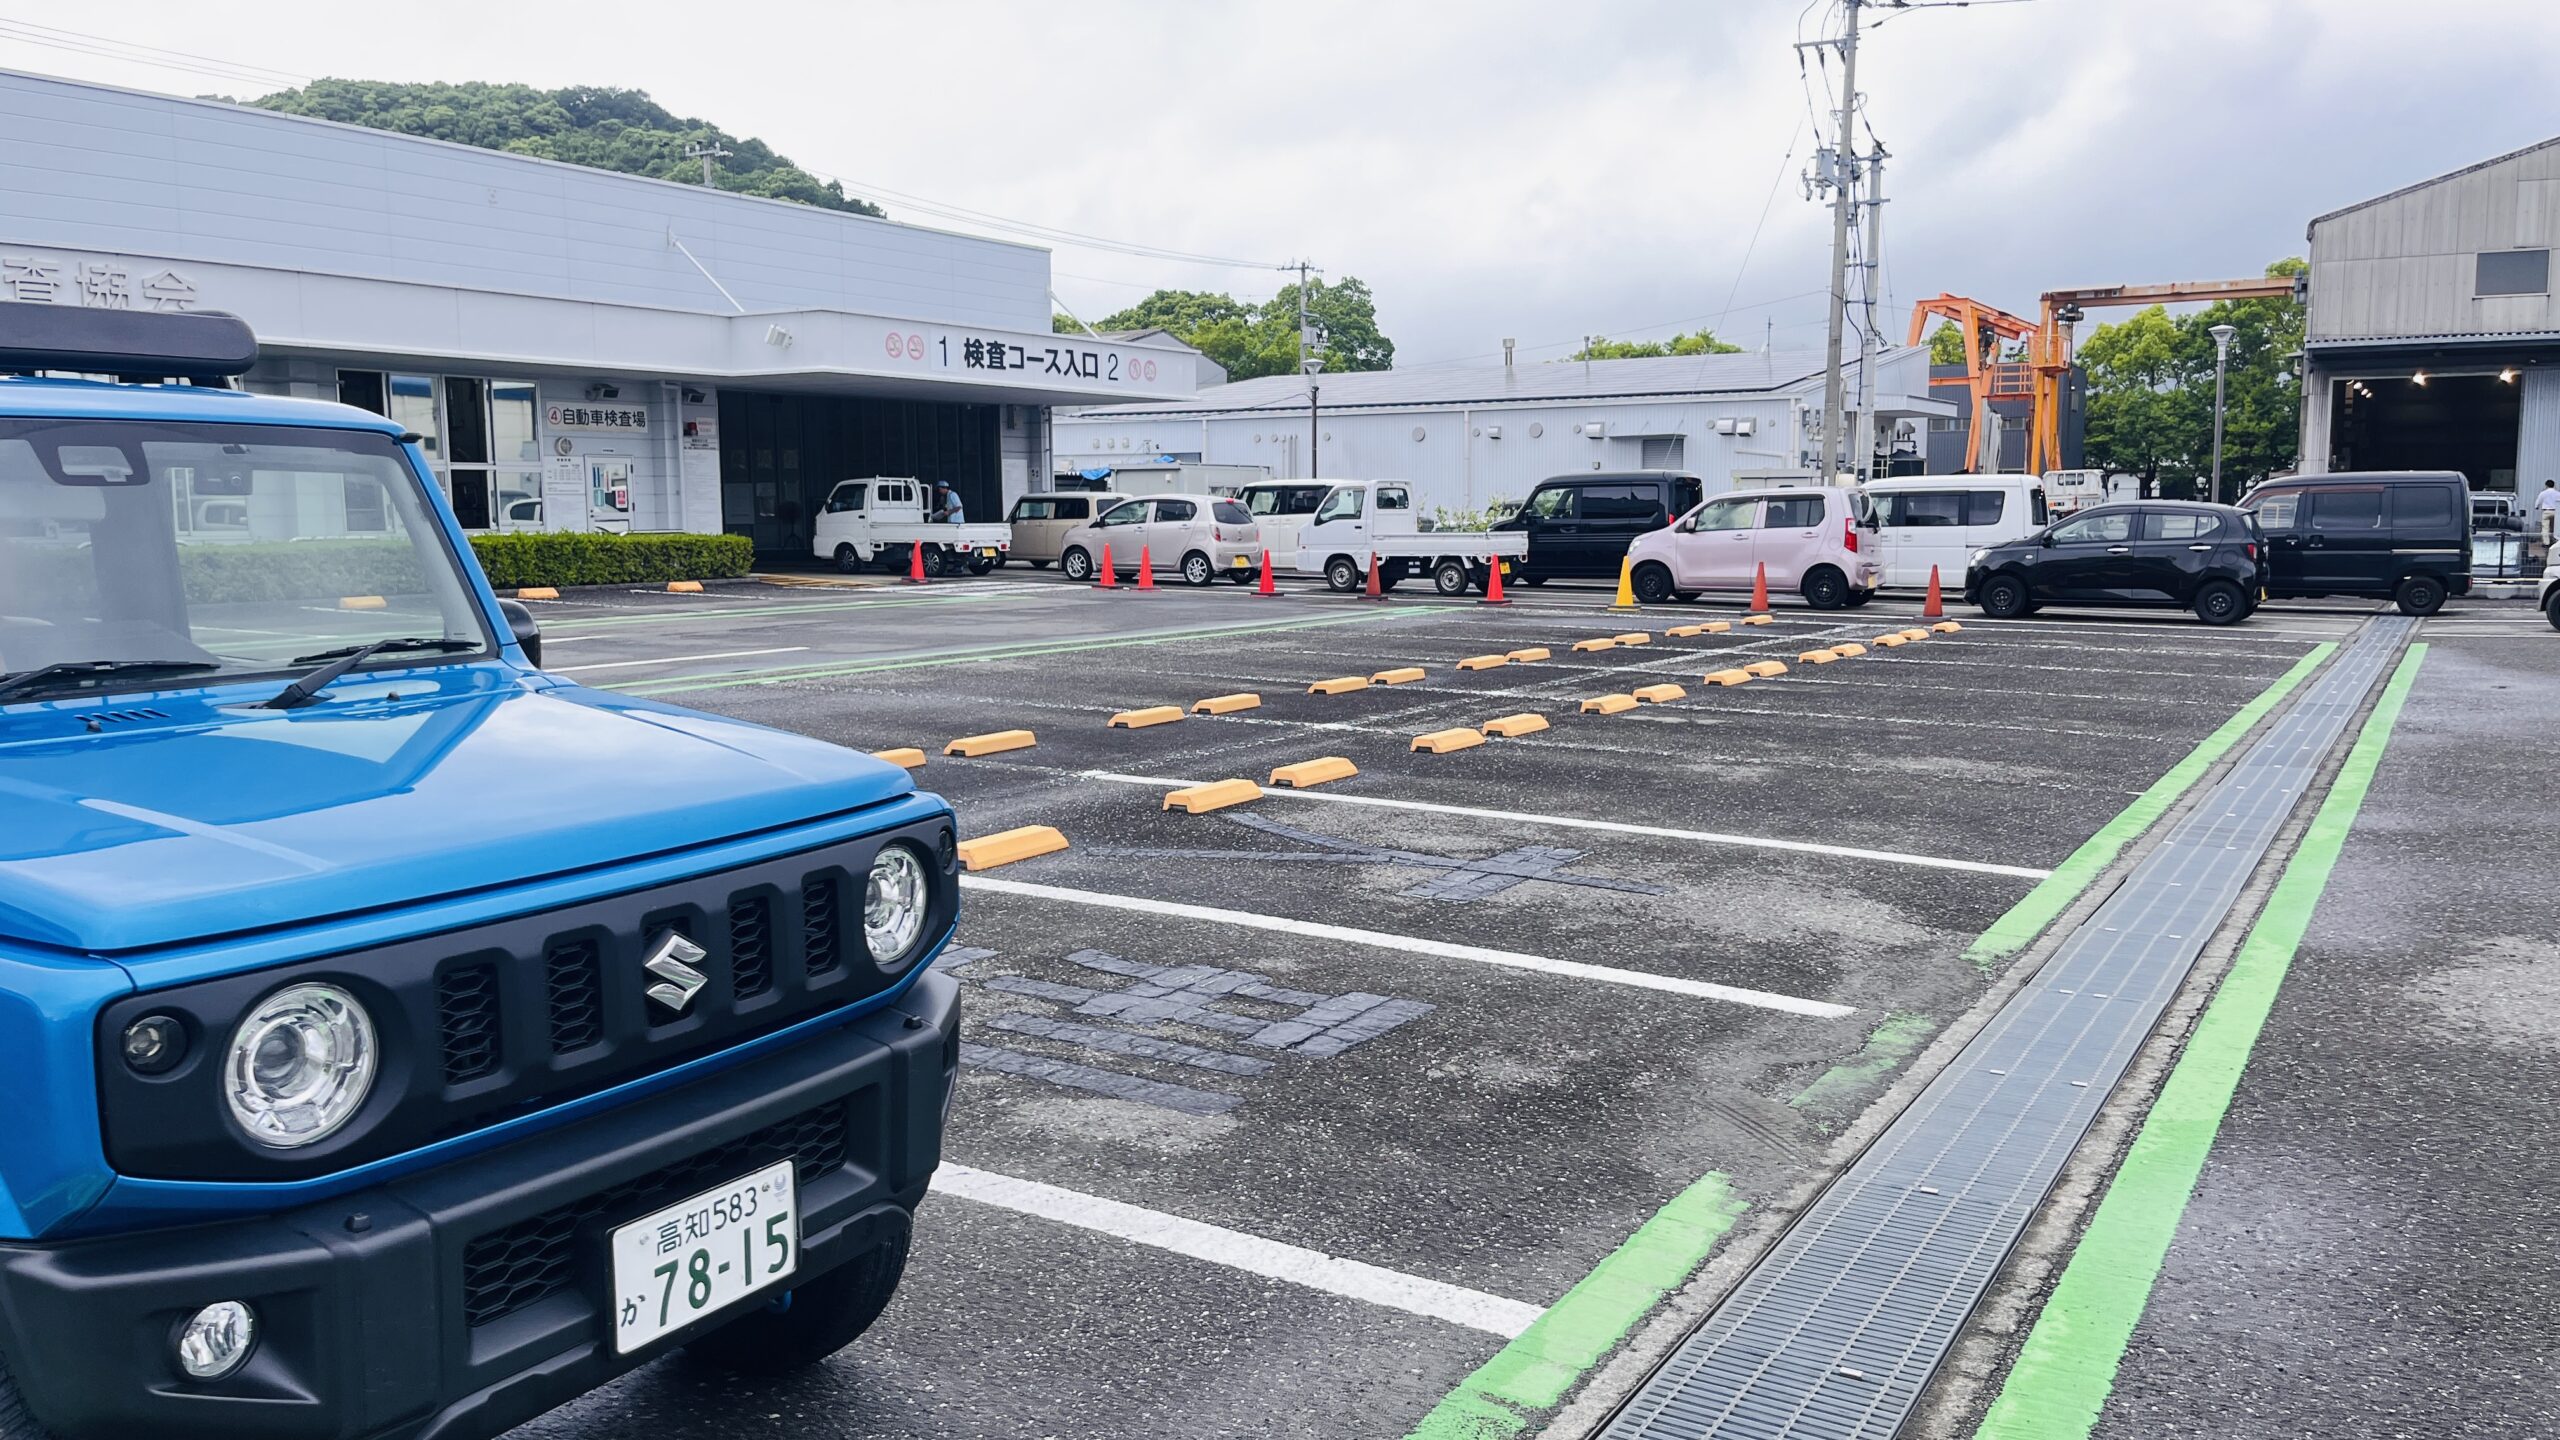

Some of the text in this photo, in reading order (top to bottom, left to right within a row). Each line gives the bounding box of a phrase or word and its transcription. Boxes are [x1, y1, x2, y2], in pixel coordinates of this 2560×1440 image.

[938, 335, 1119, 381] 1 検査コース入口 2
[654, 1210, 789, 1328] 78-15
